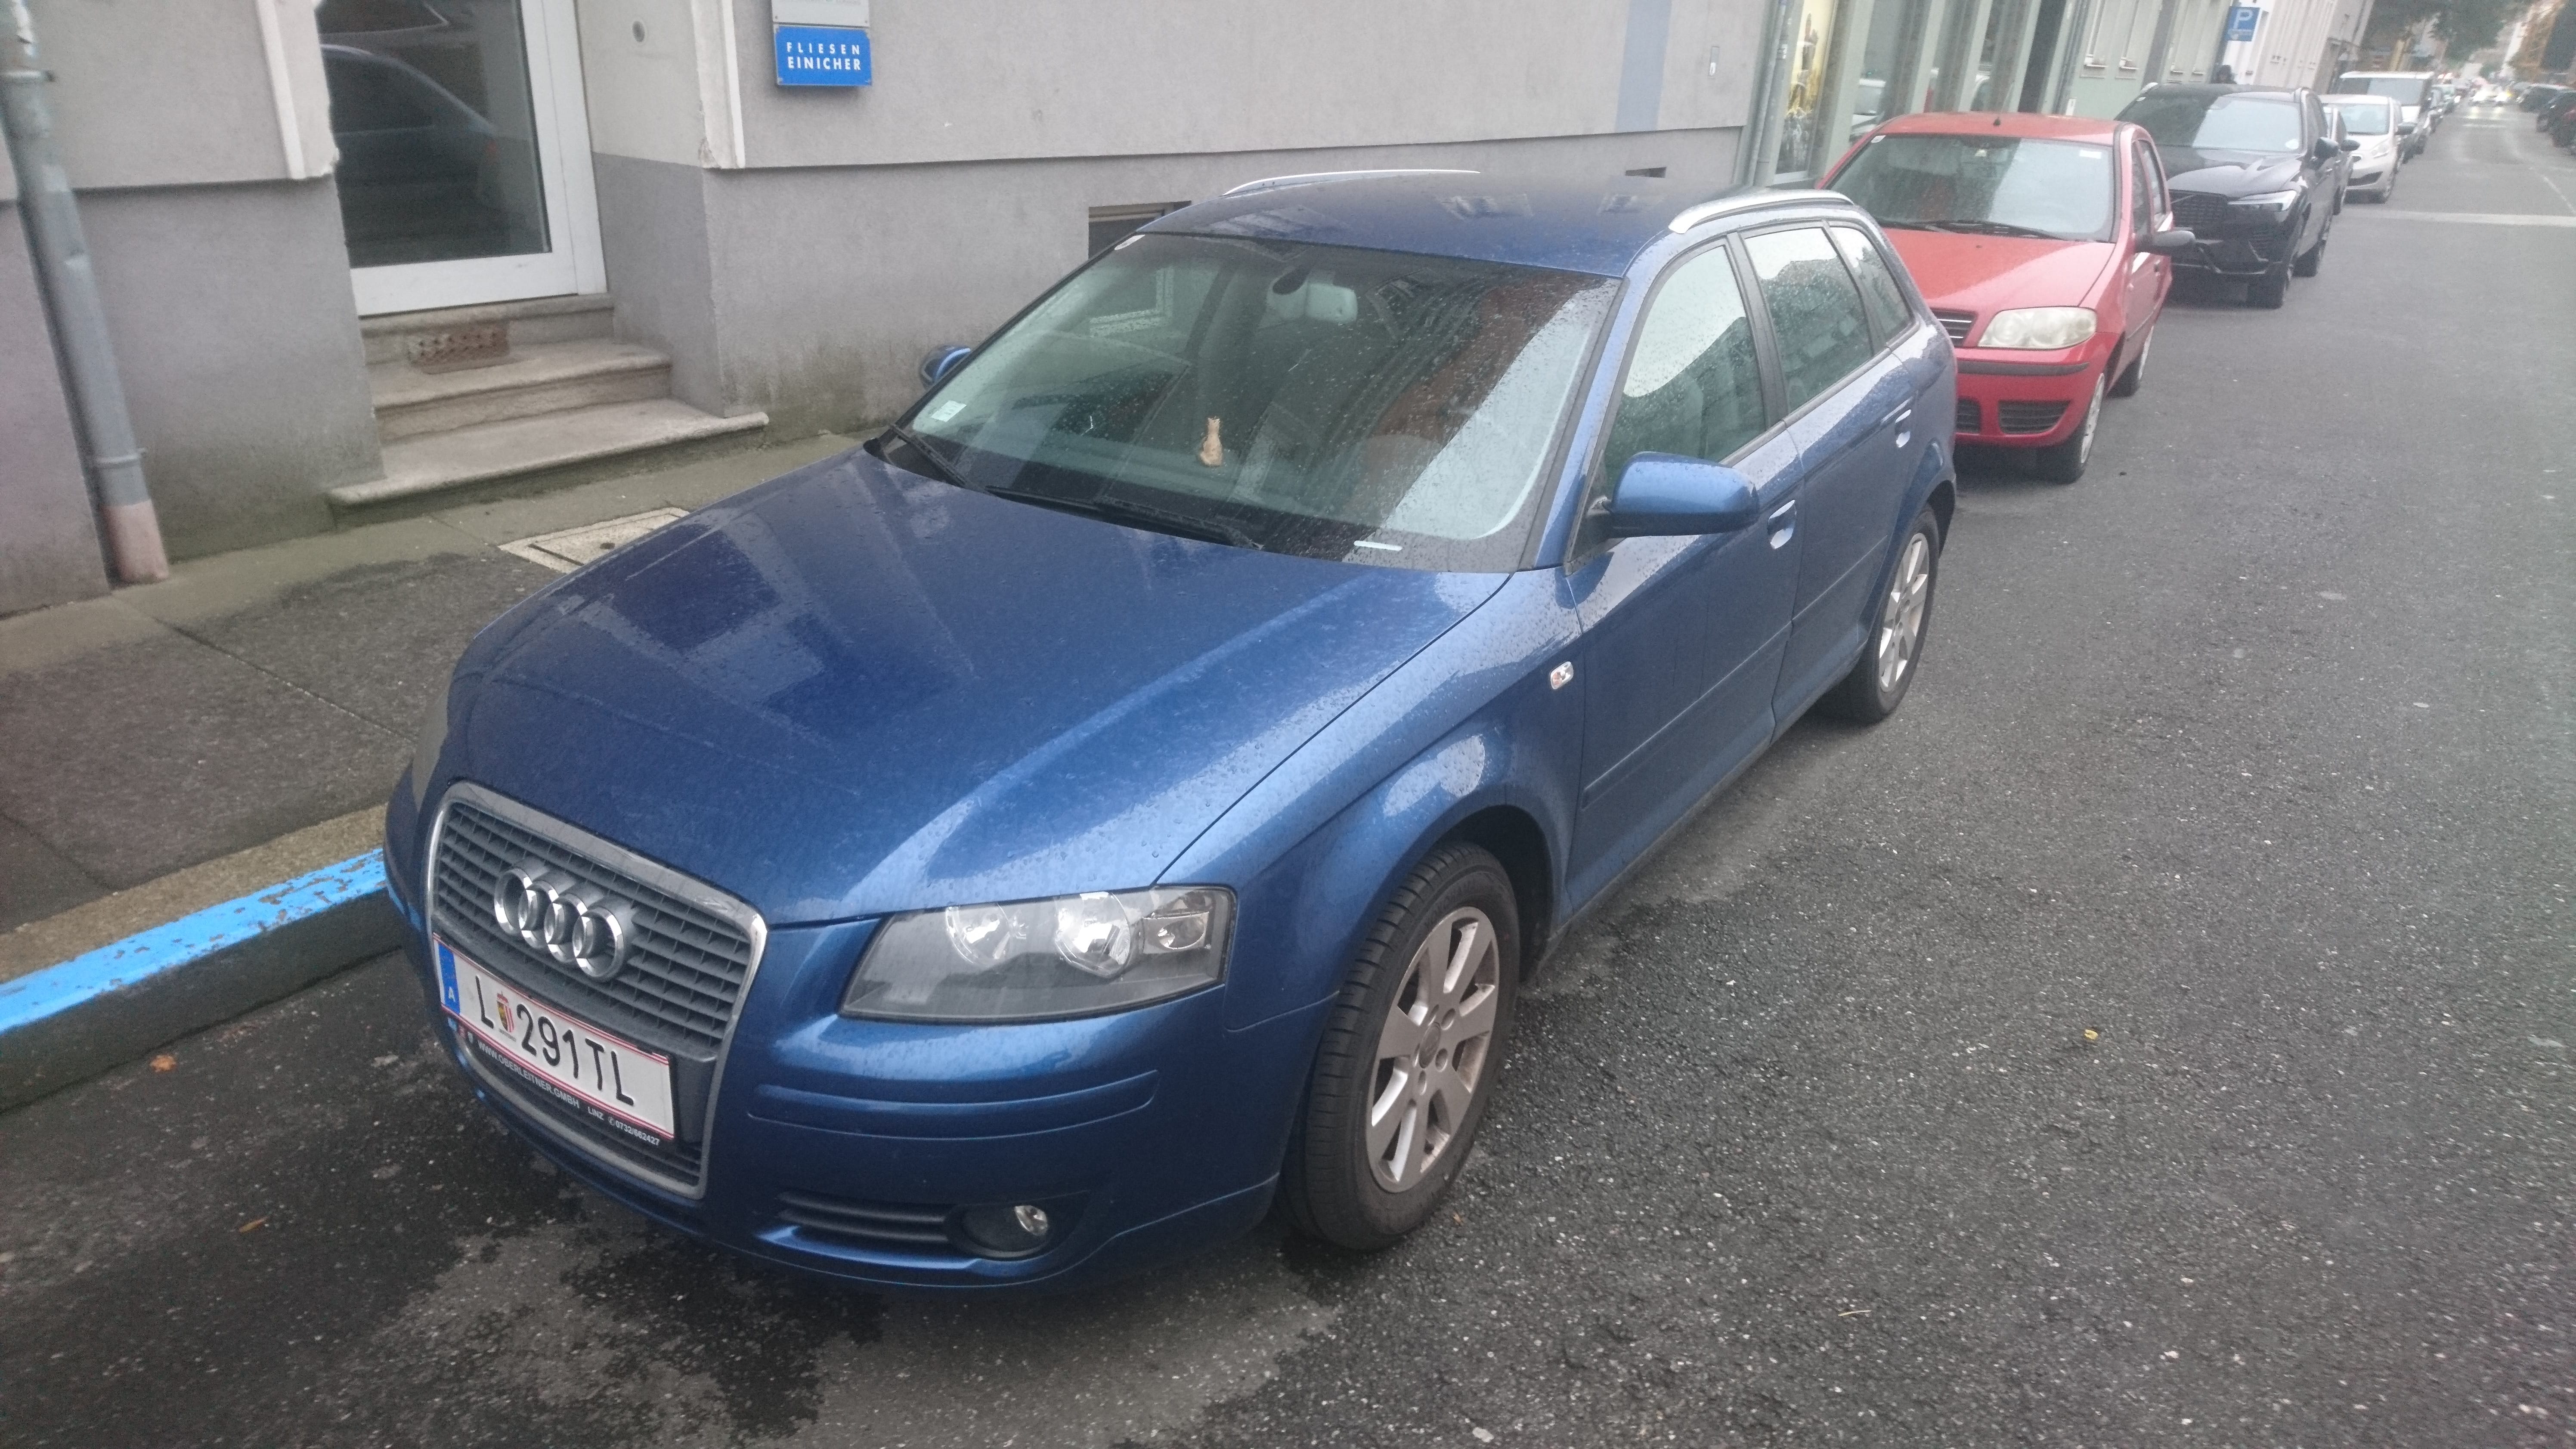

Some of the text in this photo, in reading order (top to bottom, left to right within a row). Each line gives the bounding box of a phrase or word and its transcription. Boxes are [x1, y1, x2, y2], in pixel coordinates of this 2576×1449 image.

[2232, 9, 2253, 28] P
[786, 42, 860, 55] FLIESEN
[787, 56, 861, 70] EINICHER
[449, 986, 455, 1002] A
[475, 975, 634, 1106] L 291TL
[588, 1106, 604, 1121] LINZ
